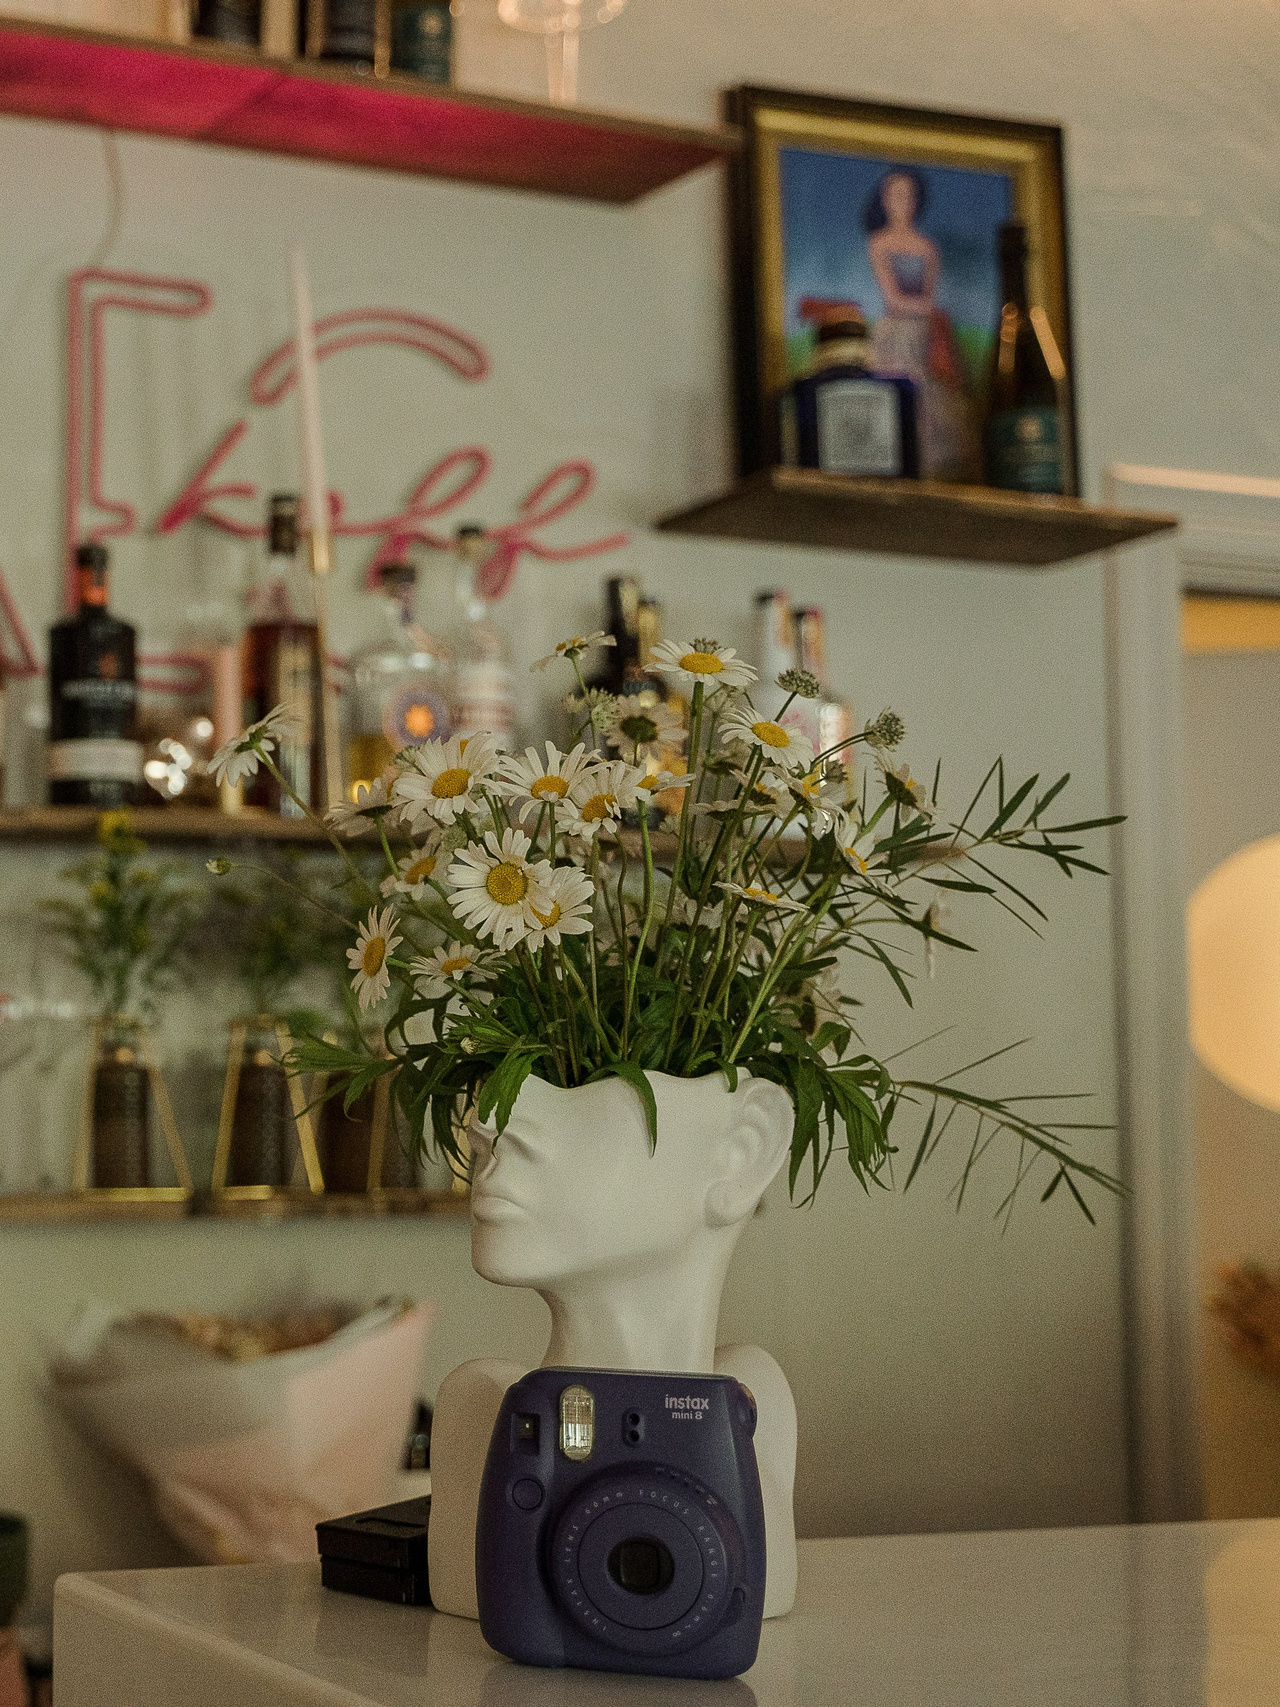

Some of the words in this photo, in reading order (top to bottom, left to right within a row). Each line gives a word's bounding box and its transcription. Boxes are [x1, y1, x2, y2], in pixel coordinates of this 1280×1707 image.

[664, 1394, 710, 1410] instax
[671, 1410, 693, 1420] mini
[694, 1410, 703, 1420] 8
[585, 1492, 623, 1515] 60mm
[639, 1490, 689, 1515] FOCUS
[564, 1524, 579, 1563] LENS
[697, 1525, 718, 1578] RANGE
[567, 1579, 607, 1631] INSTAX
